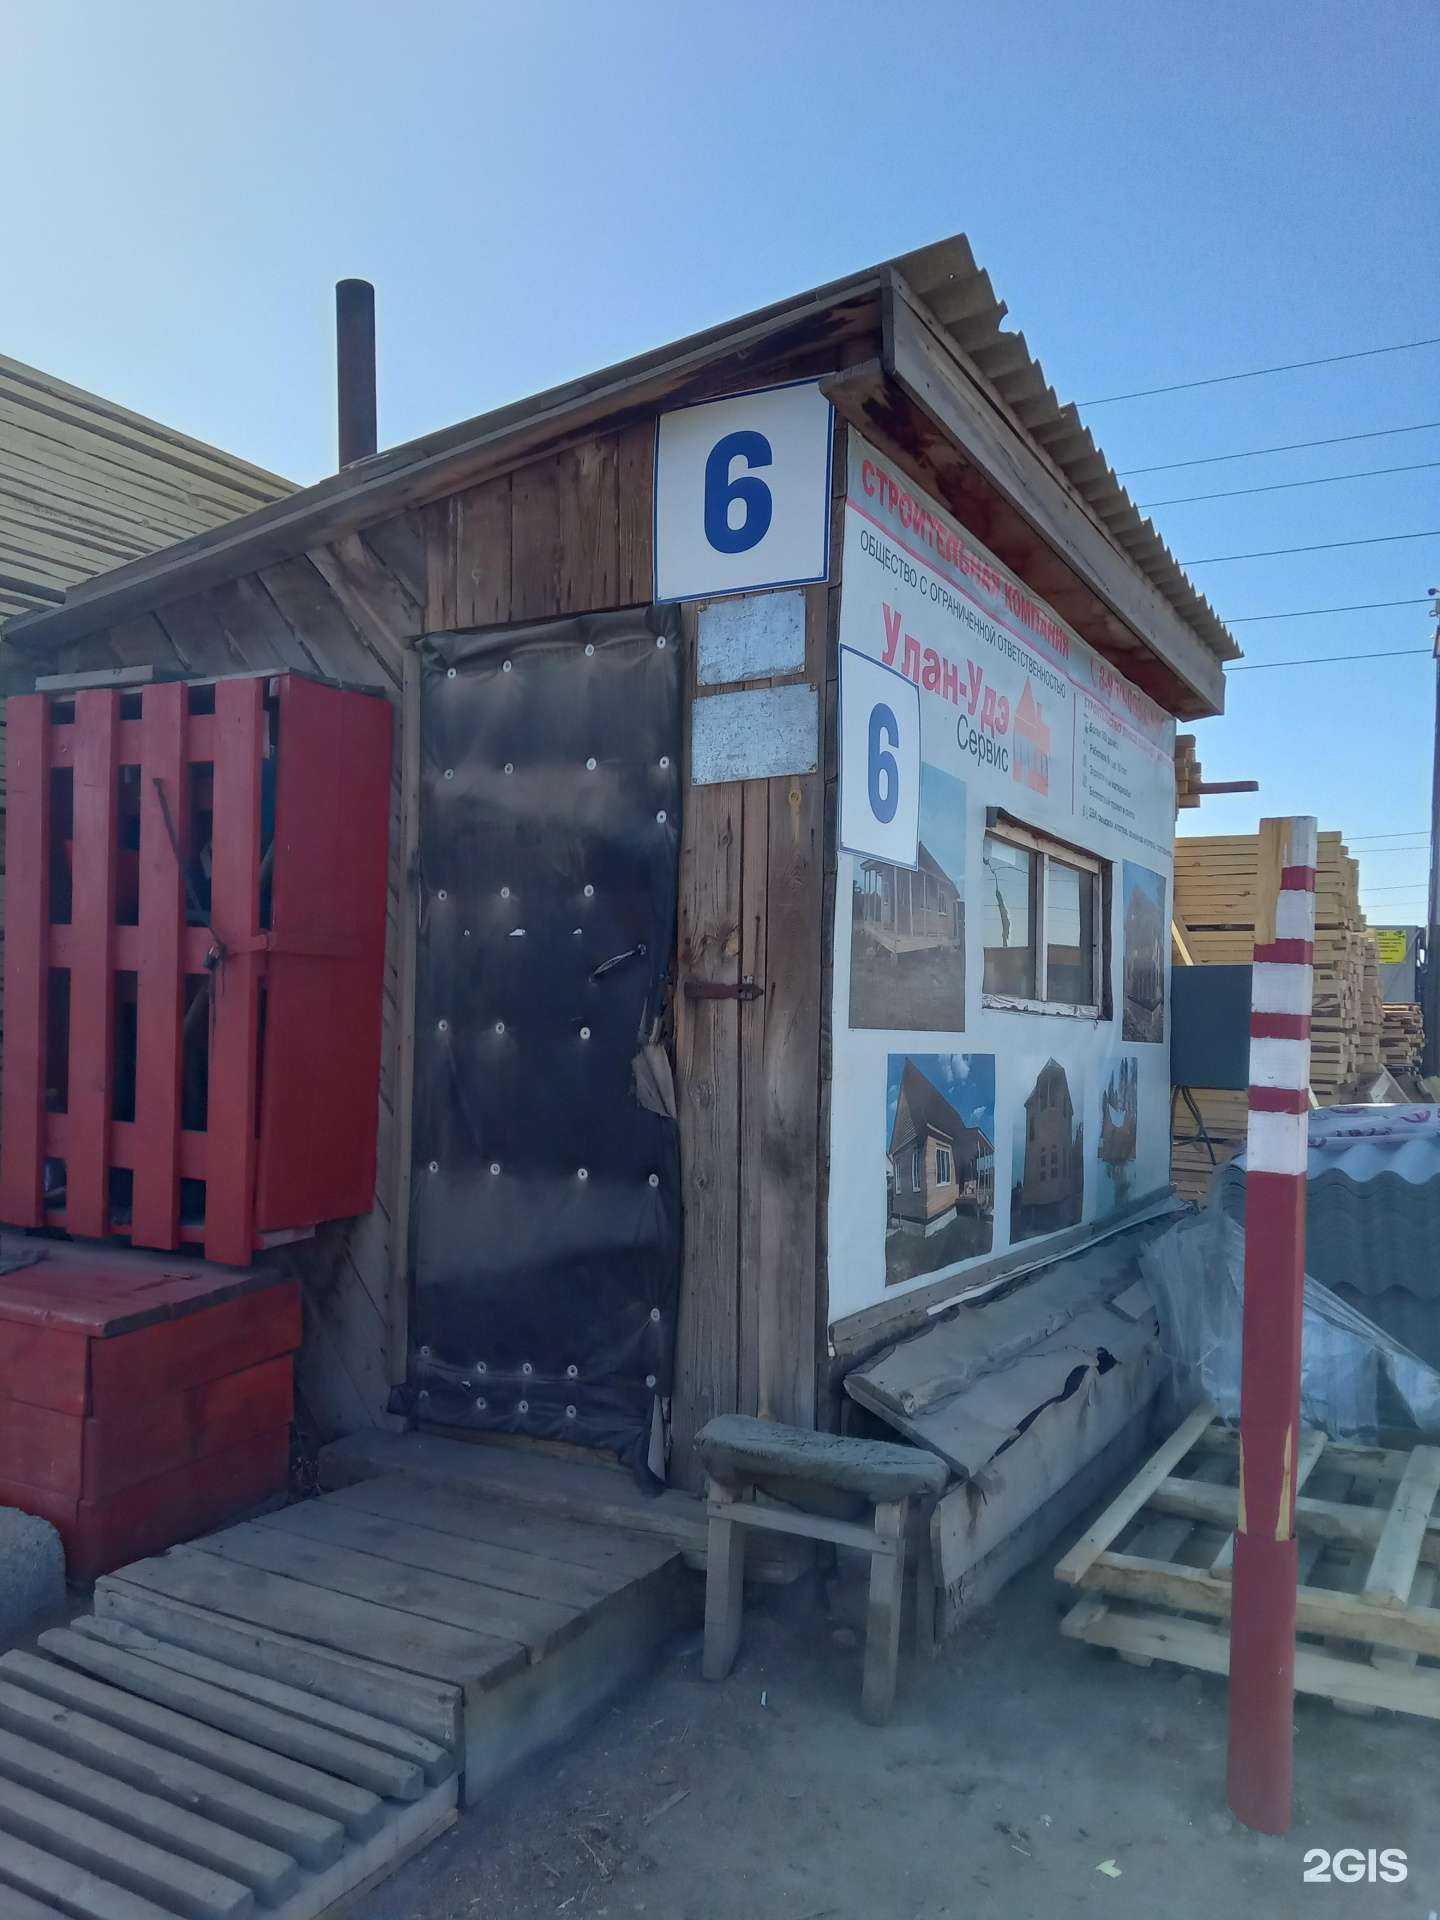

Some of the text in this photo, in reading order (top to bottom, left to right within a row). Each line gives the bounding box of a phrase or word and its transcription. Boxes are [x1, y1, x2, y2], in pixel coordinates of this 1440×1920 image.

[704, 430, 773, 555] 6
[860, 529, 917, 588] ОБЩЕСТВО
[919, 575, 928, 596] С
[930, 582, 996, 646] ОГРАНИЧЕННОЙ
[997, 634, 1066, 699] ОТВЕТСТВЕННОСТЬЮ
[881, 601, 1010, 738] Улан-Удэ
[1004, 581, 1071, 660] КОМПАНИЯ
[868, 702, 899, 824] 6
[957, 714, 1009, 773] Сервис
